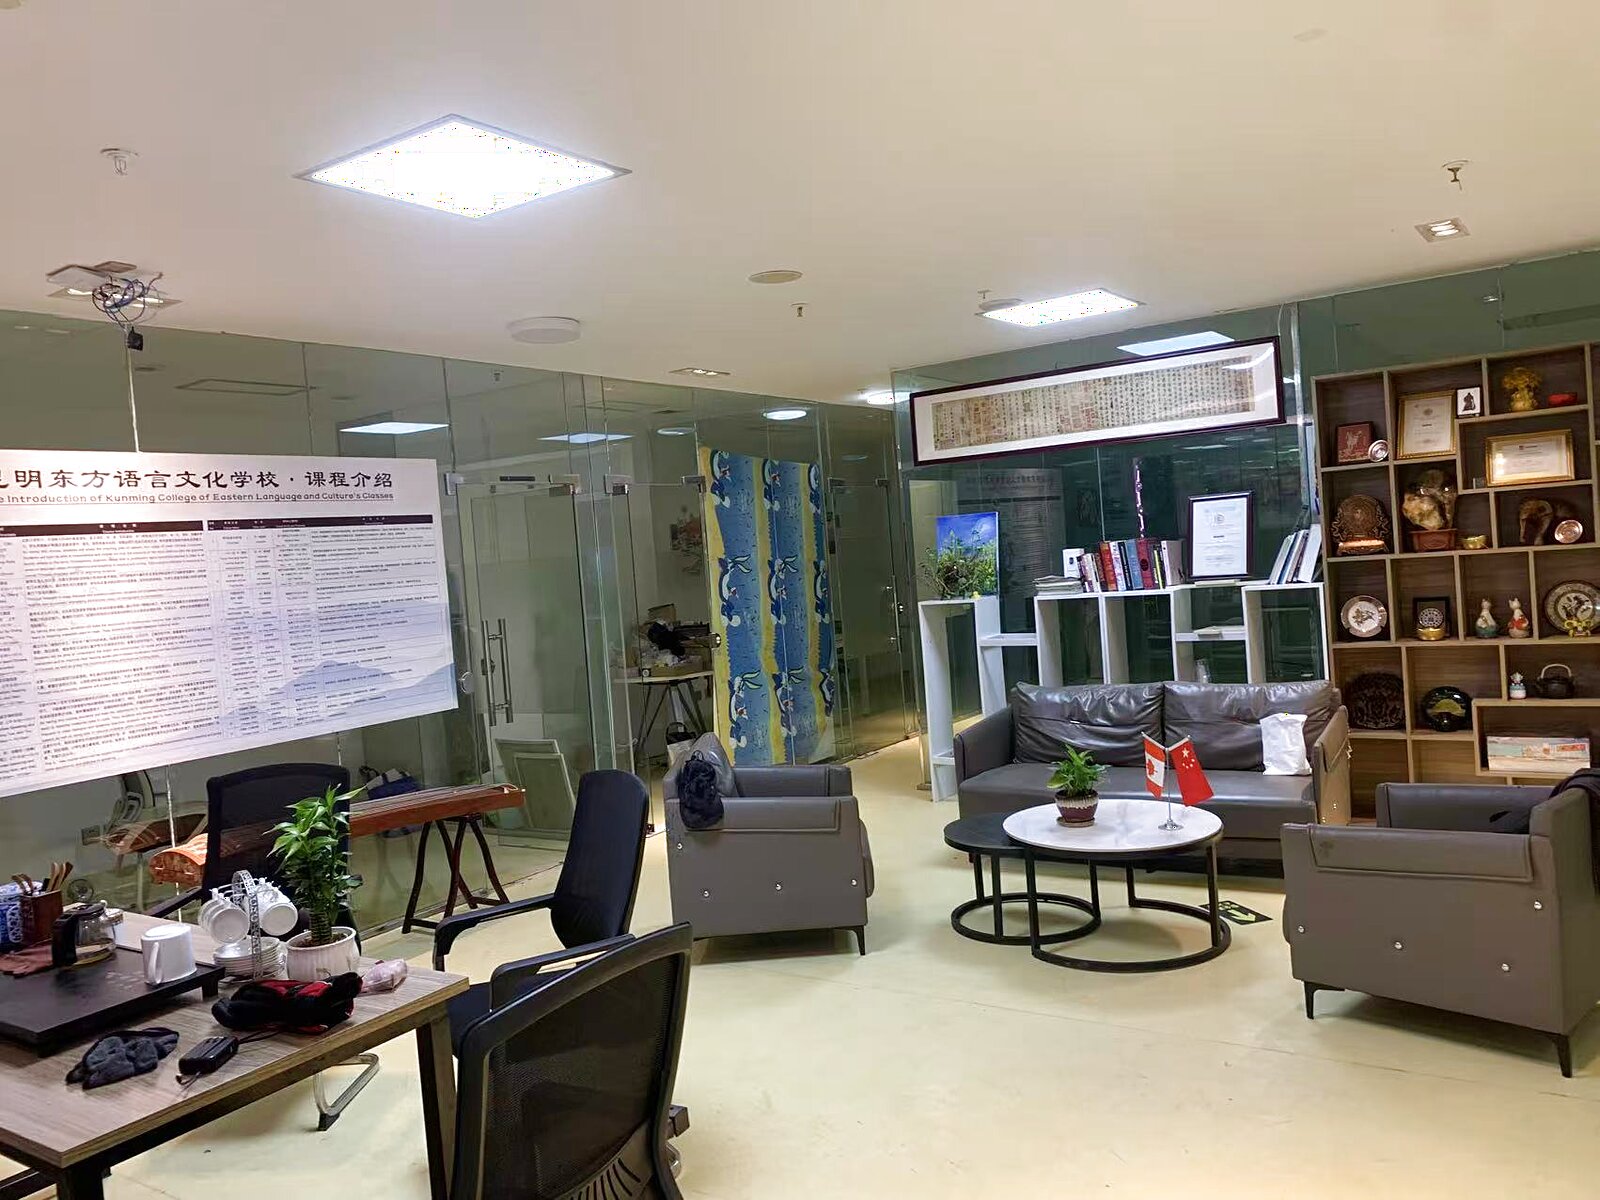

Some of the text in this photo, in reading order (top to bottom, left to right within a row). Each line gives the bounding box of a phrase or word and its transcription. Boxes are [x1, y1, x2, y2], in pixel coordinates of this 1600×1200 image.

[7, 495, 88, 503] Introduction
[90, 494, 102, 502] of
[106, 494, 155, 504] Kunming
[158, 493, 197, 503] College
[198, 493, 209, 501] of
[213, 493, 252, 501] Eastern
[256, 493, 302, 502] Language
[304, 492, 320, 500] and
